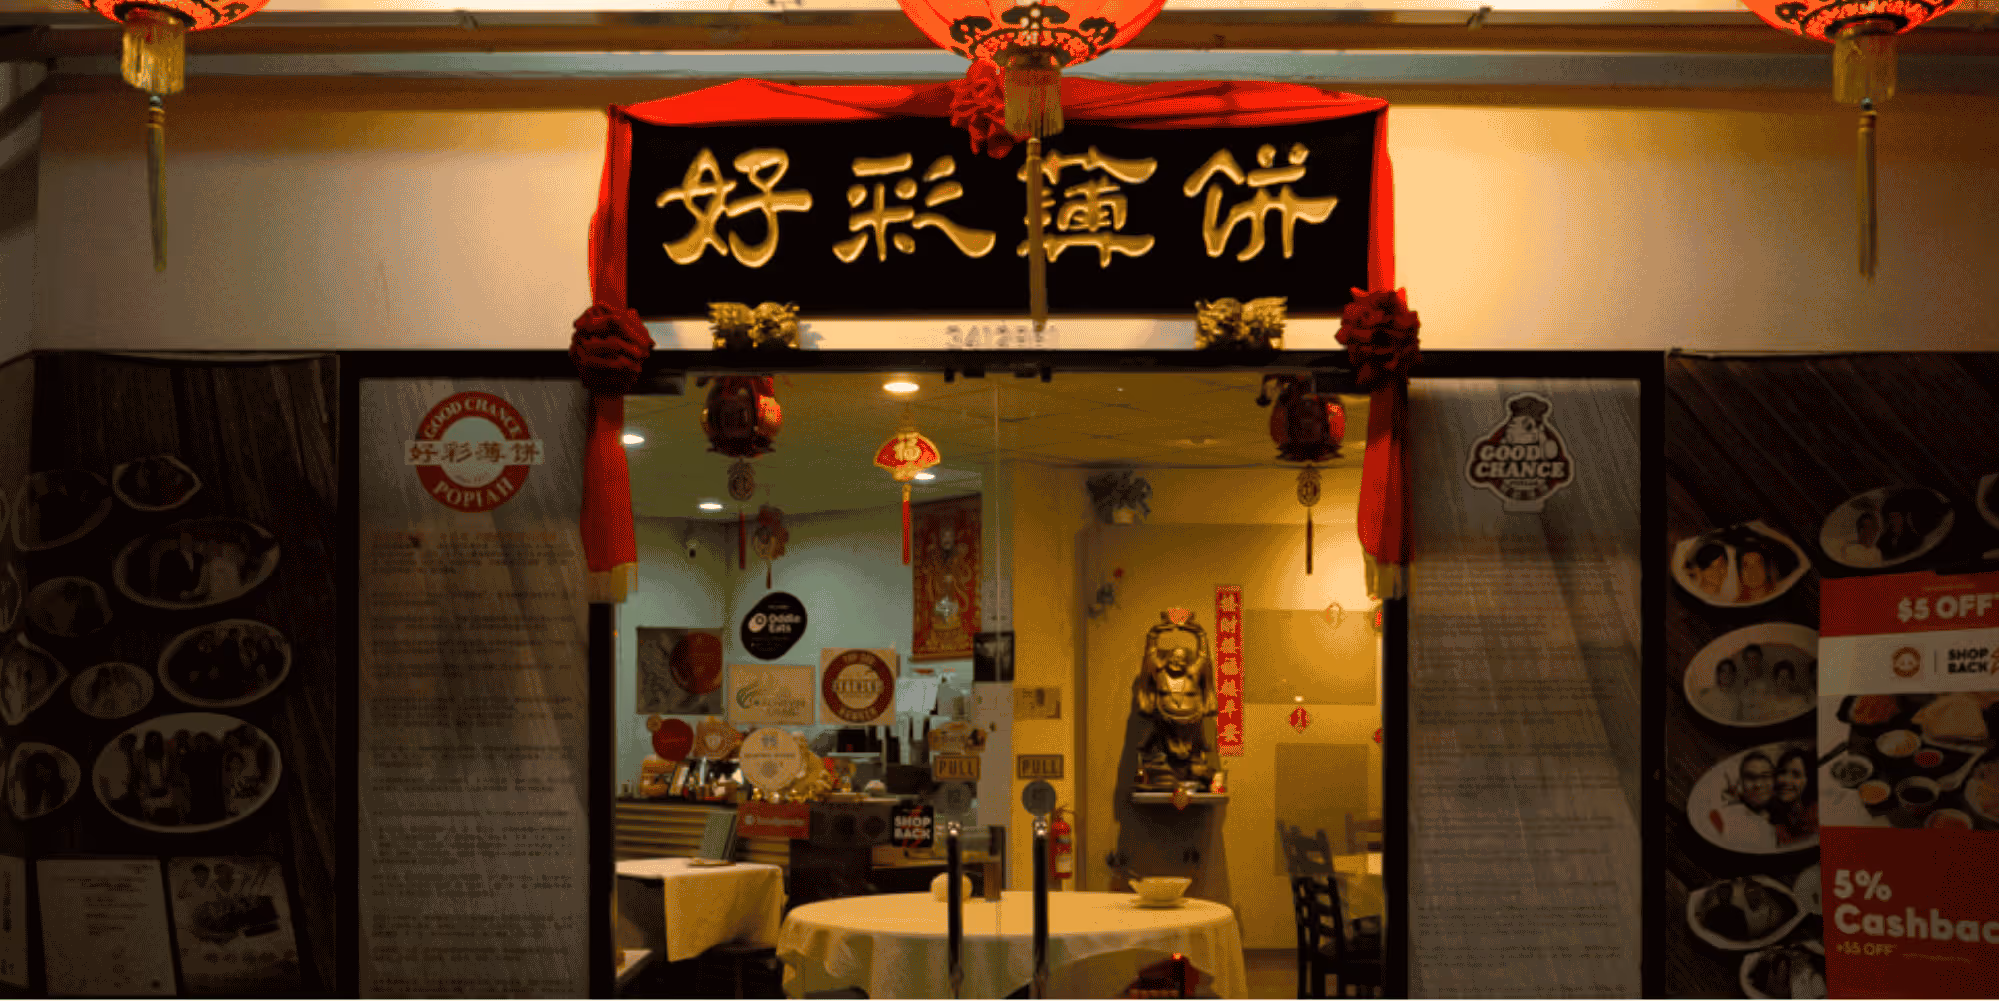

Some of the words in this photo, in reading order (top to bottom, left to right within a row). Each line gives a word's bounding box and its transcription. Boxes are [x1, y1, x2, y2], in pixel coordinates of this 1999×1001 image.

[424, 401, 462, 438] GOOD
[464, 398, 521, 433] CHANCE
[1479, 445, 1540, 461] GOOD
[1475, 461, 1565, 478] CHANCE
[433, 477, 514, 507] POPIAH
[1897, 595, 1931, 623] $5
[767, 612, 802, 624] Oddle
[767, 623, 792, 634] Eats
[1948, 647, 1989, 661] SHOP
[1948, 661, 1989, 674] BACK
[938, 759, 975, 775] PULL
[1021, 759, 1059, 776] PULL
[893, 815, 932, 827] SHOP
[893, 828, 931, 840] BACK
[1833, 868, 1893, 902] 5%
[1834, 903, 1999, 944] Cashbac
